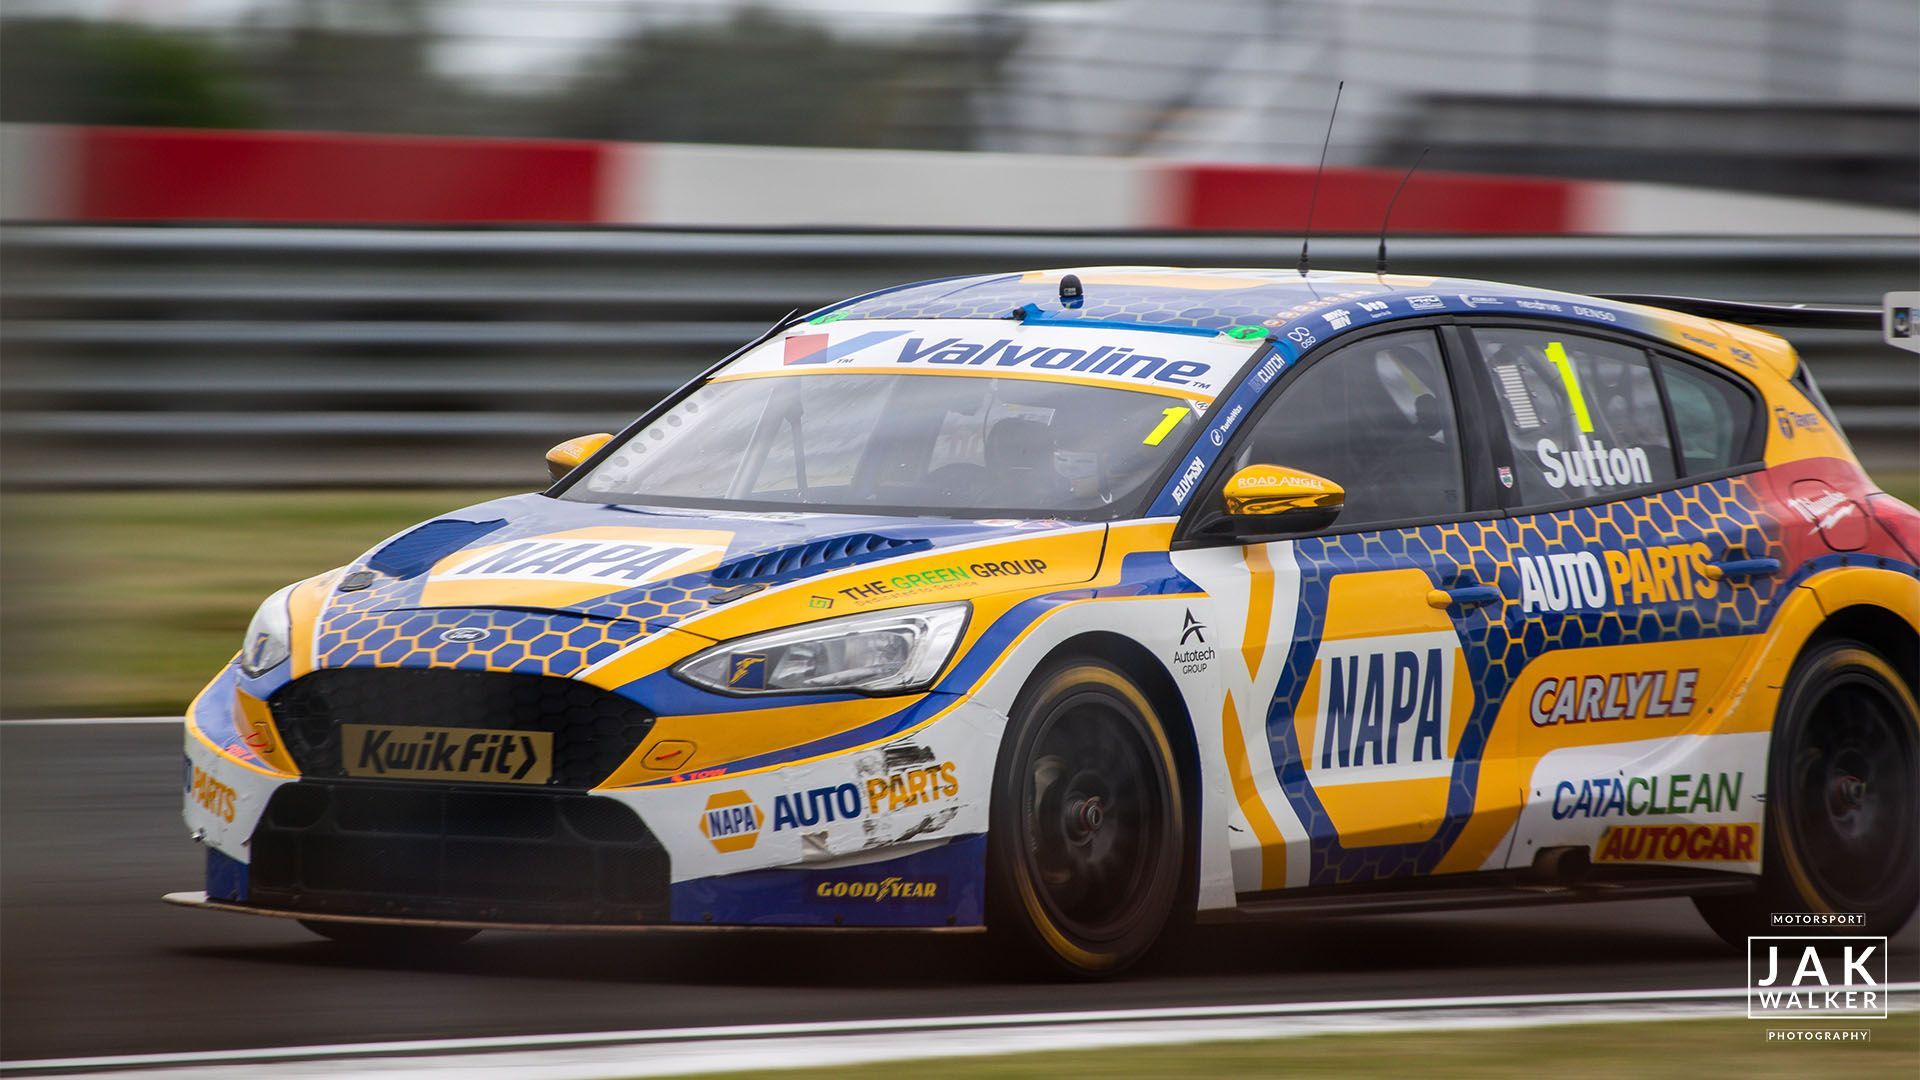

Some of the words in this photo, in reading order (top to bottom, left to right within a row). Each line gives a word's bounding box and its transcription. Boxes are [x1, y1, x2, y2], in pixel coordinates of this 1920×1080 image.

[896, 337, 1211, 385] Valvoline
[1544, 342, 1594, 432] 1
[1143, 406, 1191, 447] 1
[1238, 476, 1277, 487] ROAD
[1279, 477, 1323, 489] ANGEL
[1537, 435, 1653, 489] Sutton
[456, 542, 693, 580] NAPA
[838, 580, 894, 601] THE
[891, 566, 971, 590] GREEN
[970, 559, 1048, 578] GROUP
[1518, 550, 1607, 613] AUTO
[1603, 542, 1719, 606] PARTS
[1173, 647, 1216, 665] Autotech
[1182, 663, 1208, 675] GROUP
[1321, 648, 1442, 769] NAPA
[1530, 667, 1700, 727] CARLYLE
[773, 782, 863, 832] AUTO
[865, 761, 960, 814] PARTS
[1552, 772, 1744, 821] CATACLEAN
[708, 803, 757, 838] NAPA
[1600, 825, 1755, 862] AUTOCAR
